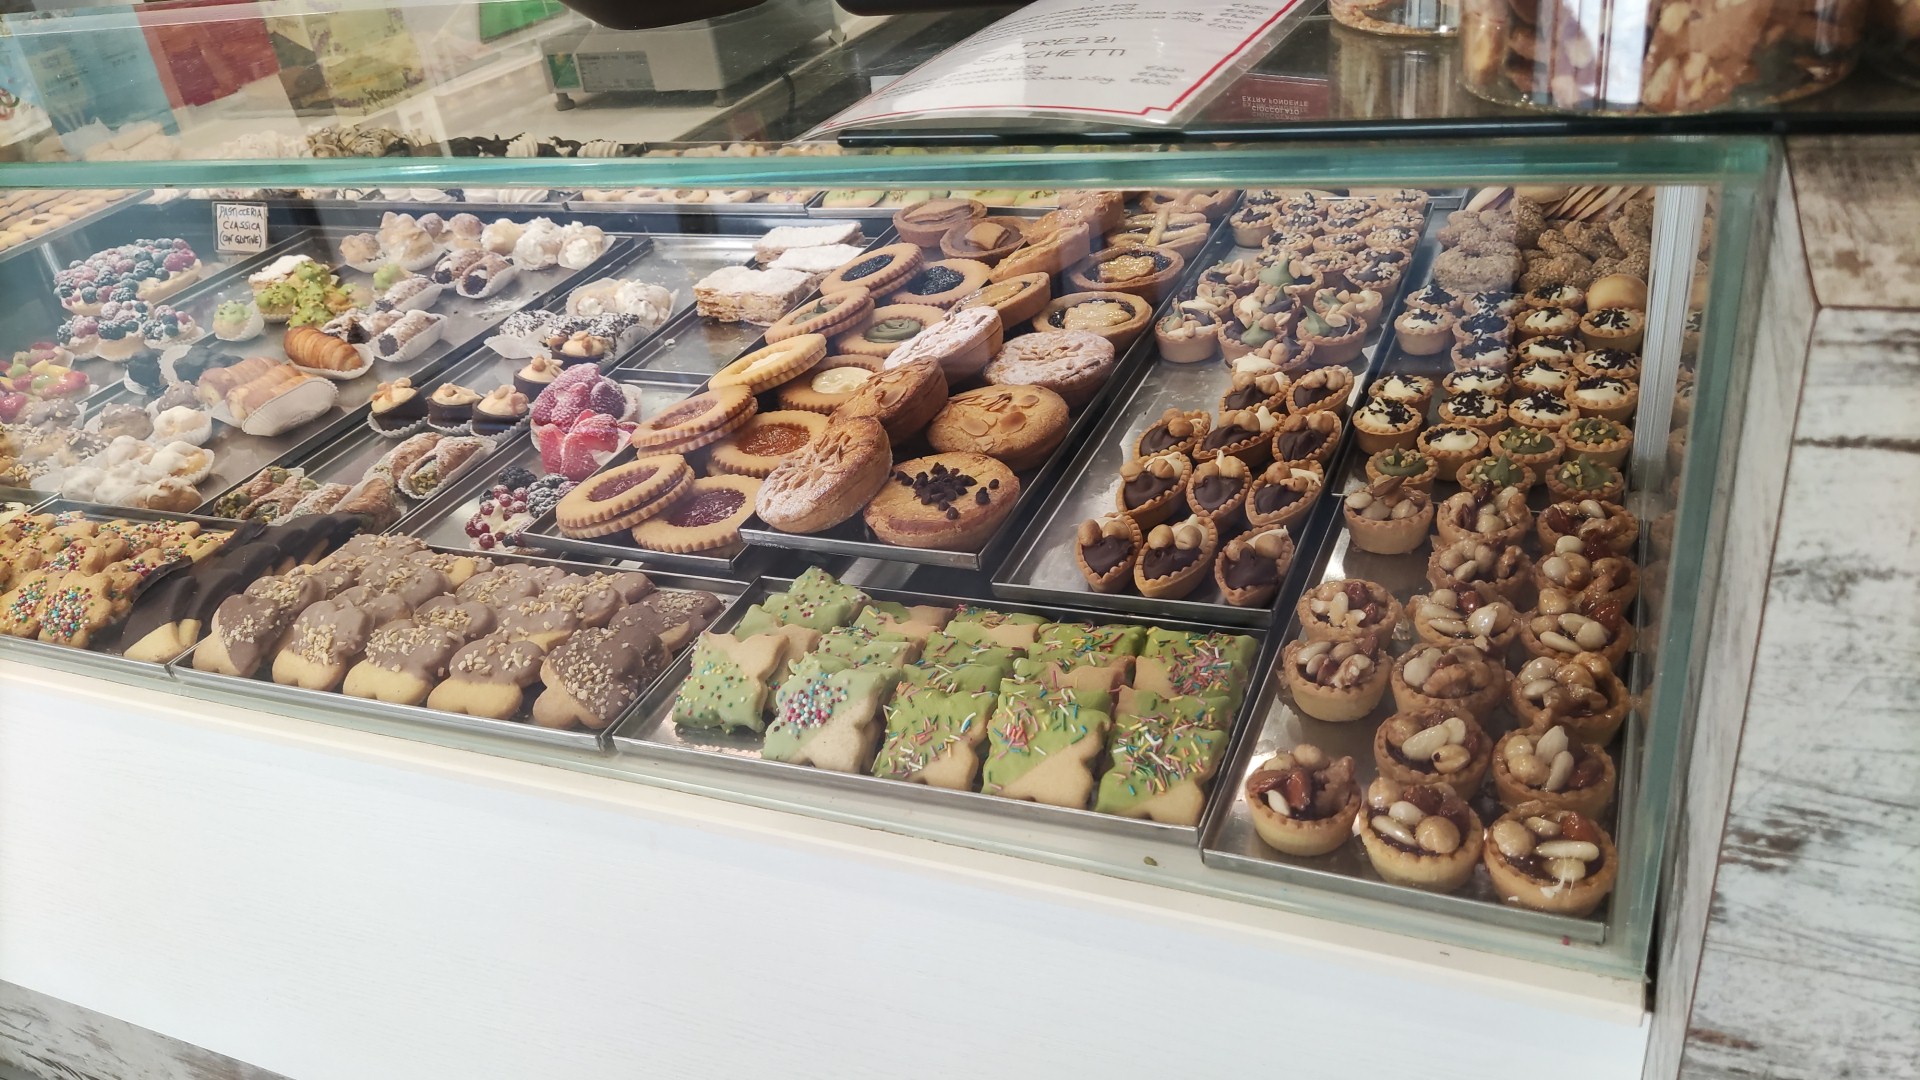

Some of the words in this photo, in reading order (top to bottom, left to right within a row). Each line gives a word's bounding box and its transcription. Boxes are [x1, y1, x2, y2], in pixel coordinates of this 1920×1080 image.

[1022, 36, 1116, 48] PREZZI
[218, 206, 263, 219] PASTICCERIA
[222, 221, 262, 232] CLASSICA
